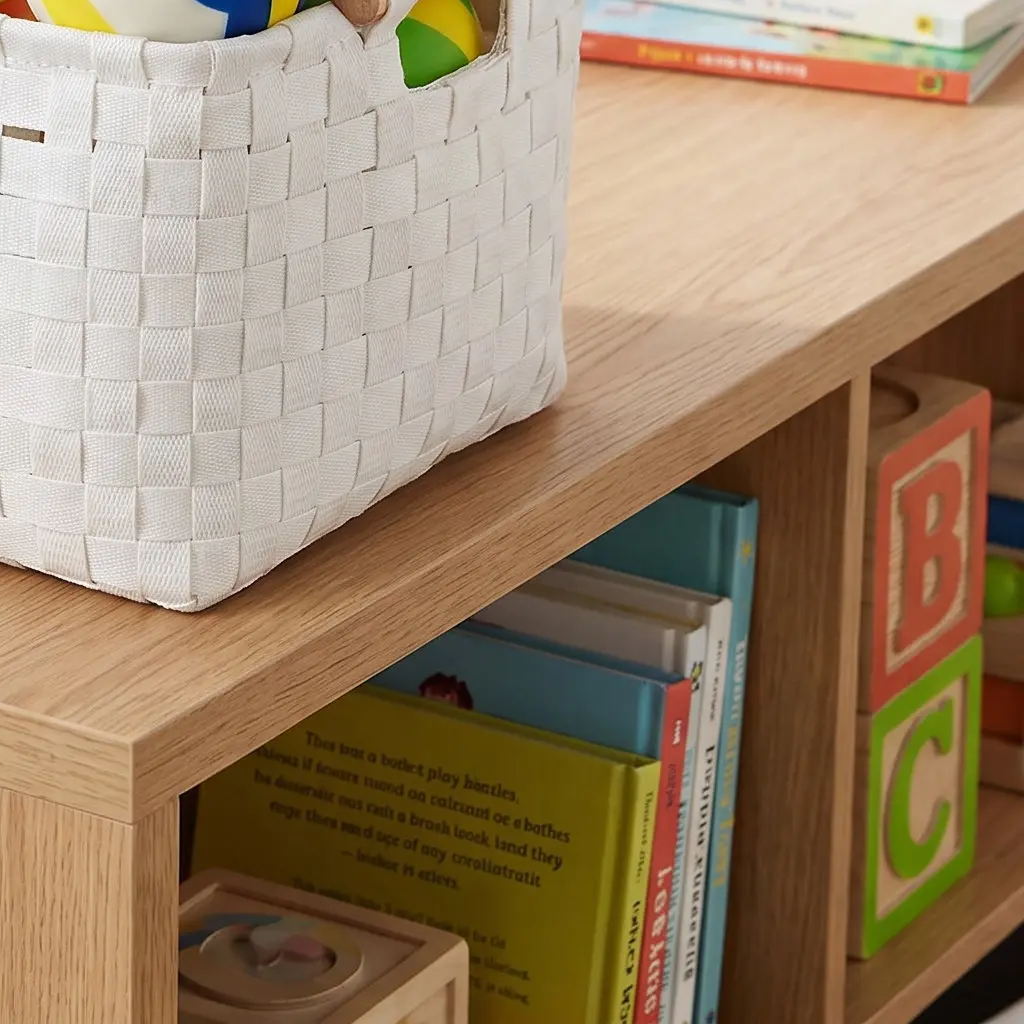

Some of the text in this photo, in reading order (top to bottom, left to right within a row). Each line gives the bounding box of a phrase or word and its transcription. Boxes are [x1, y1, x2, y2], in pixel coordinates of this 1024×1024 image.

[897, 459, 963, 657] B
[427, 767, 460, 791] play
[887, 697, 954, 878] C
[403, 838, 420, 853] of
[532, 847, 564, 873] they
